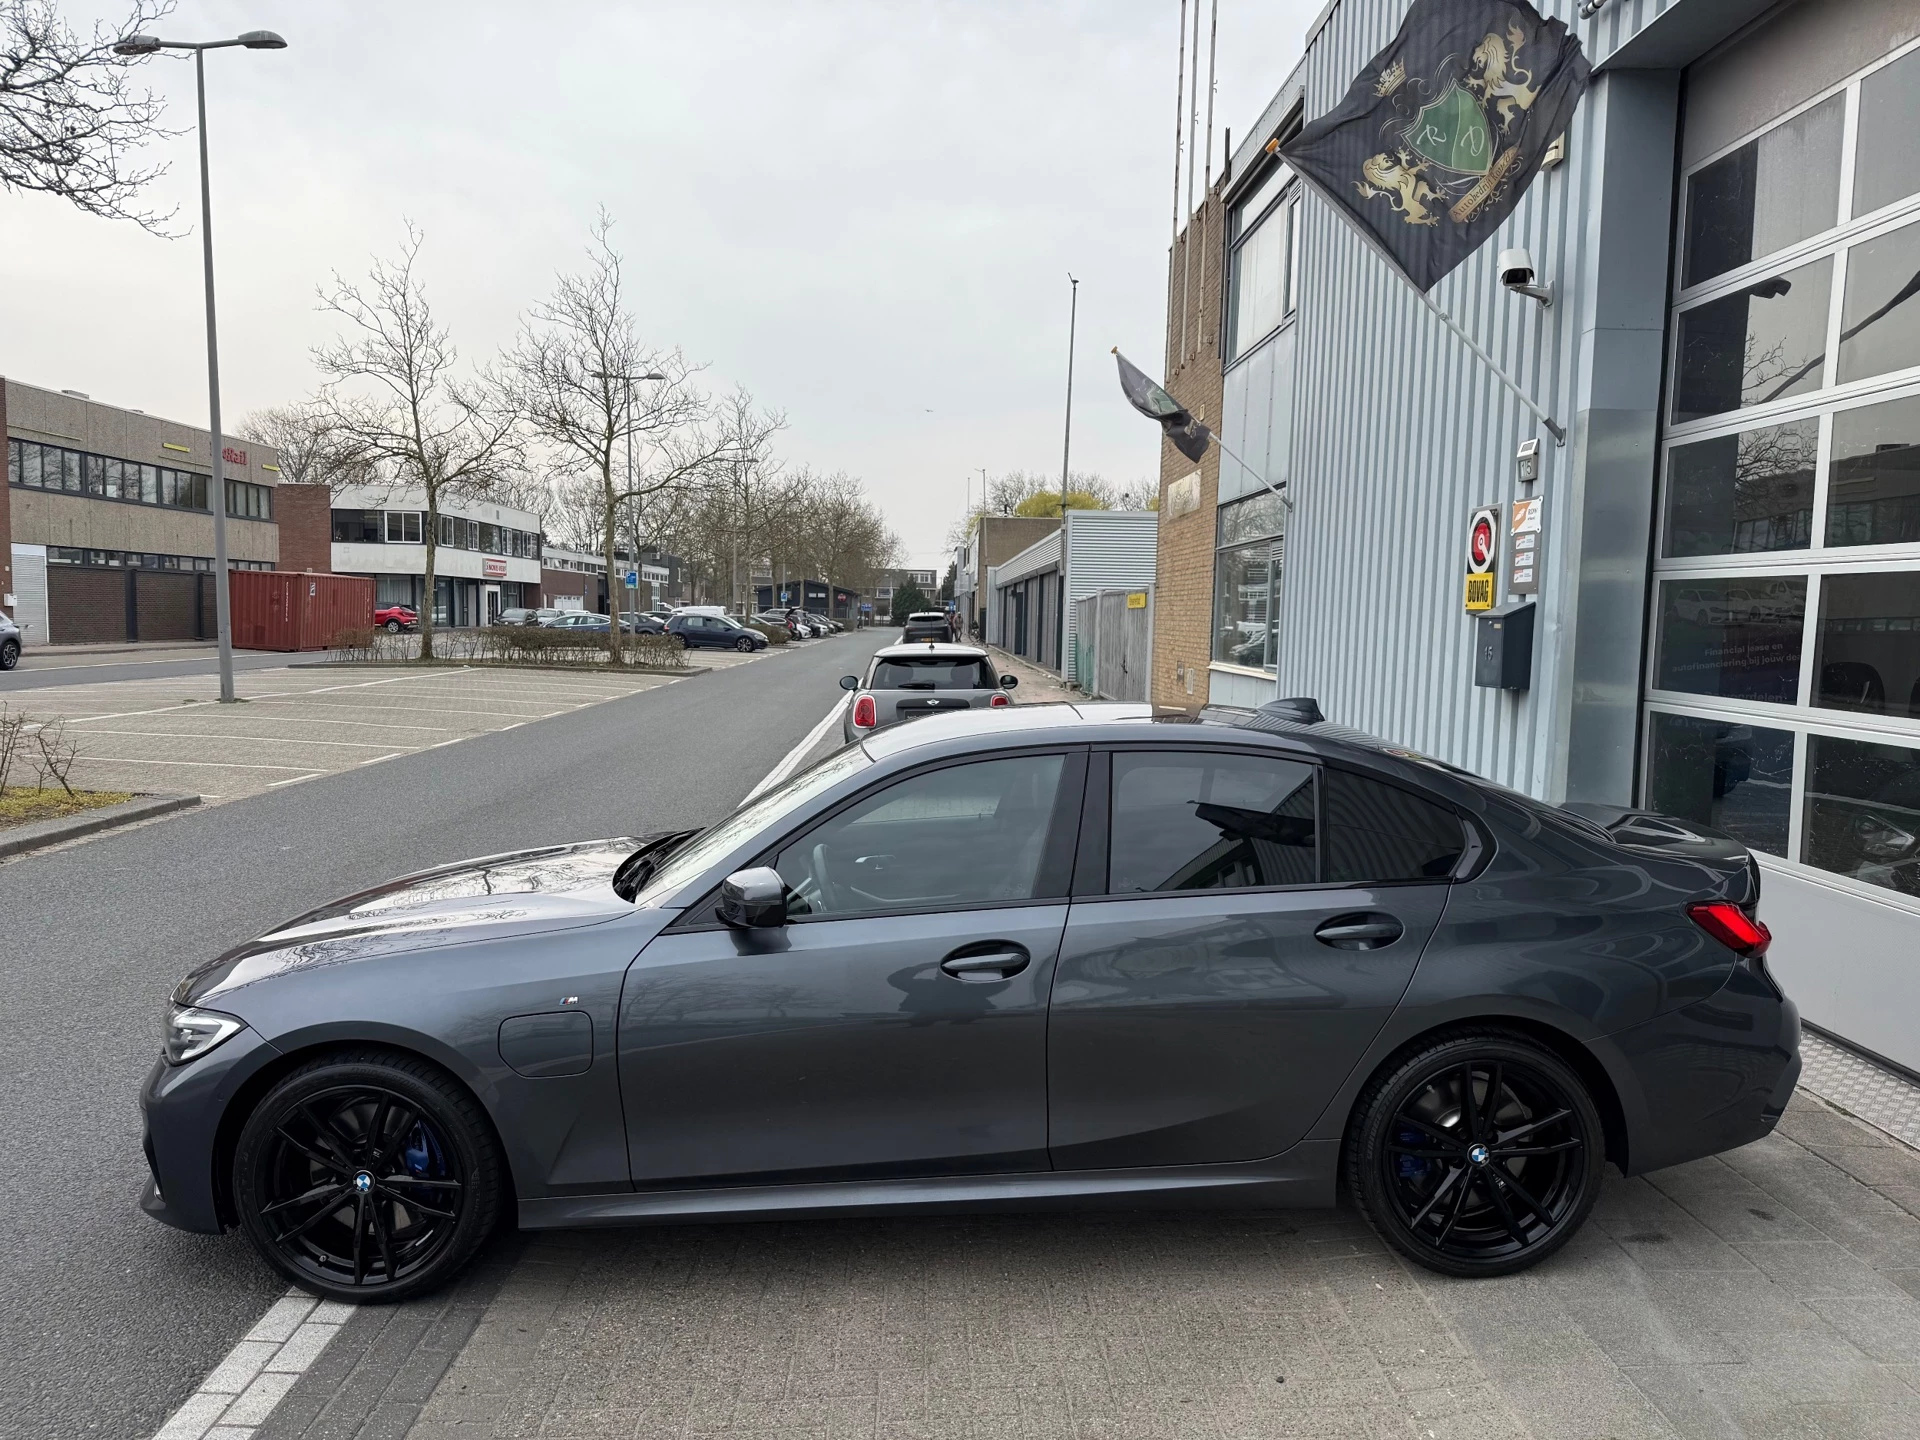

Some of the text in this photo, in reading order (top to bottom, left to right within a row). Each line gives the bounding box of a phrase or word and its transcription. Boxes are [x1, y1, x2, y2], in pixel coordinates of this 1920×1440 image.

[1521, 460, 1532, 476] 15
[1468, 579, 1489, 603] BOVAG
[1704, 646, 1745, 656] Financial
[1672, 659, 1747, 672] autofinanciering
[1762, 655, 1785, 665] jouw
